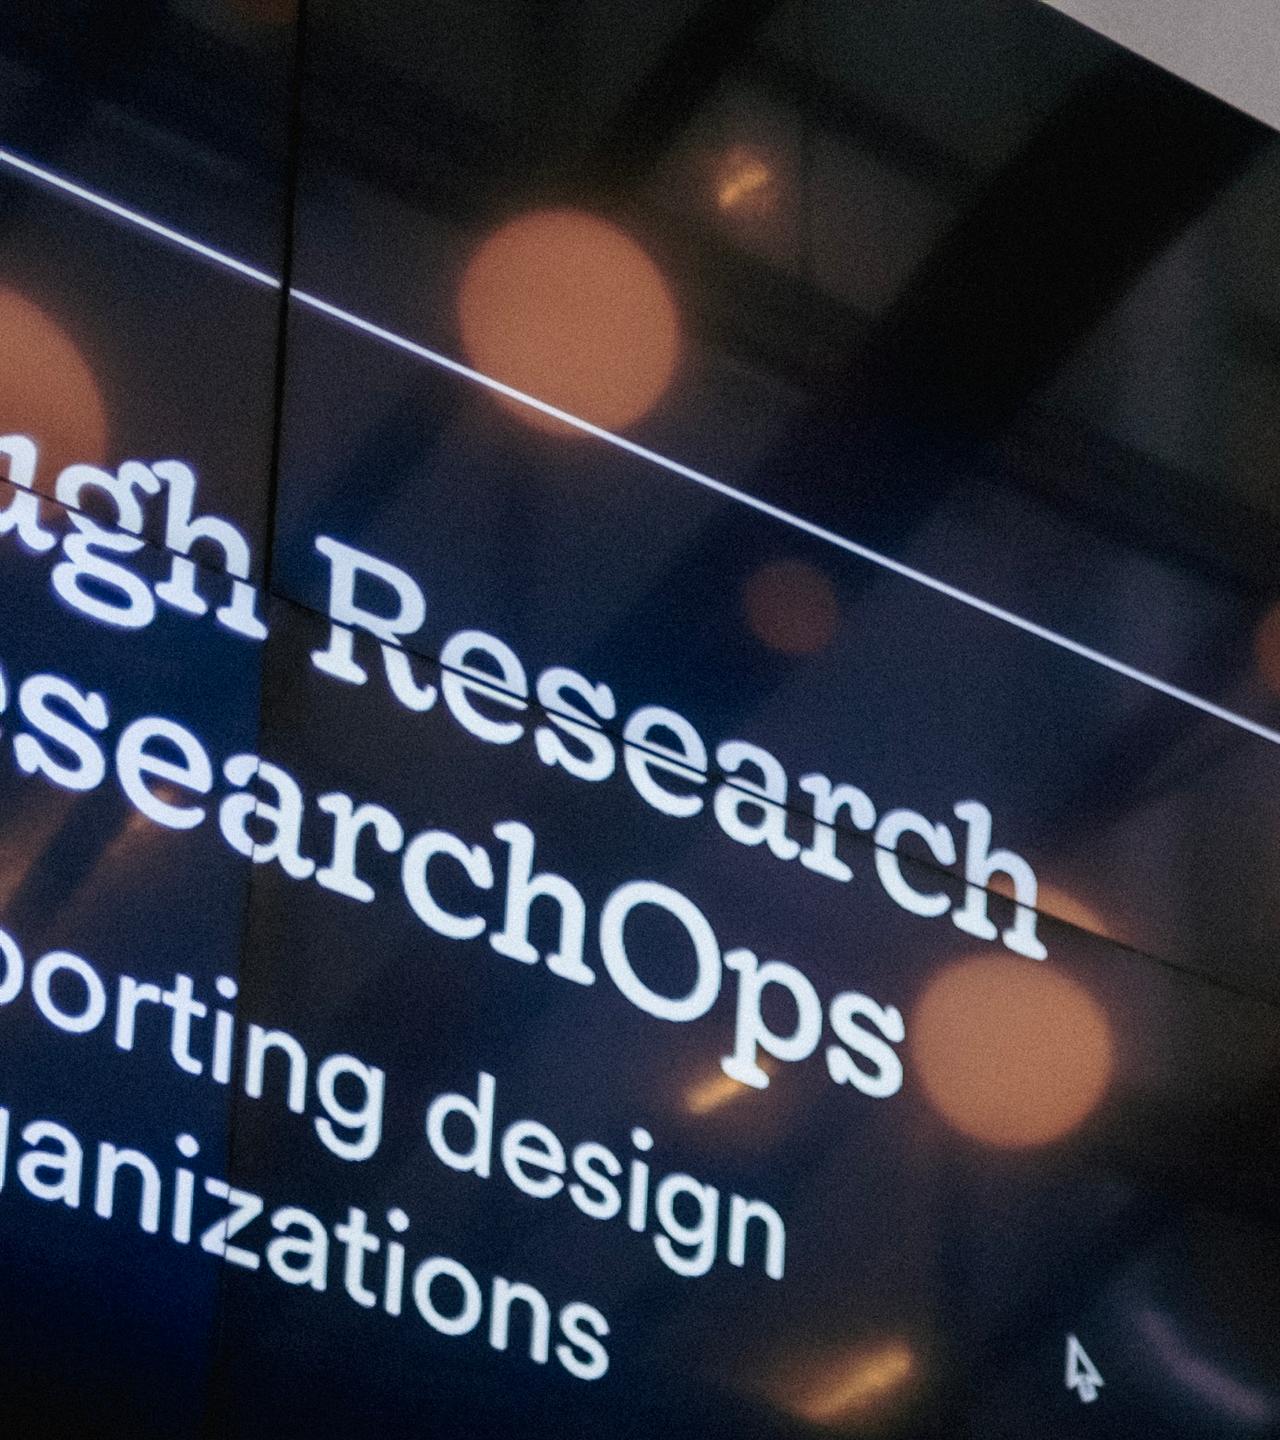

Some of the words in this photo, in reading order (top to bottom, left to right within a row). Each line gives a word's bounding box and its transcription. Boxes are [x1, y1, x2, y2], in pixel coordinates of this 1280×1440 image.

[0, 662, 906, 1099] searchOps
[311, 535, 1048, 963] Research
[0, 1106, 610, 1381] anizations
[426, 1072, 787, 1280] design
